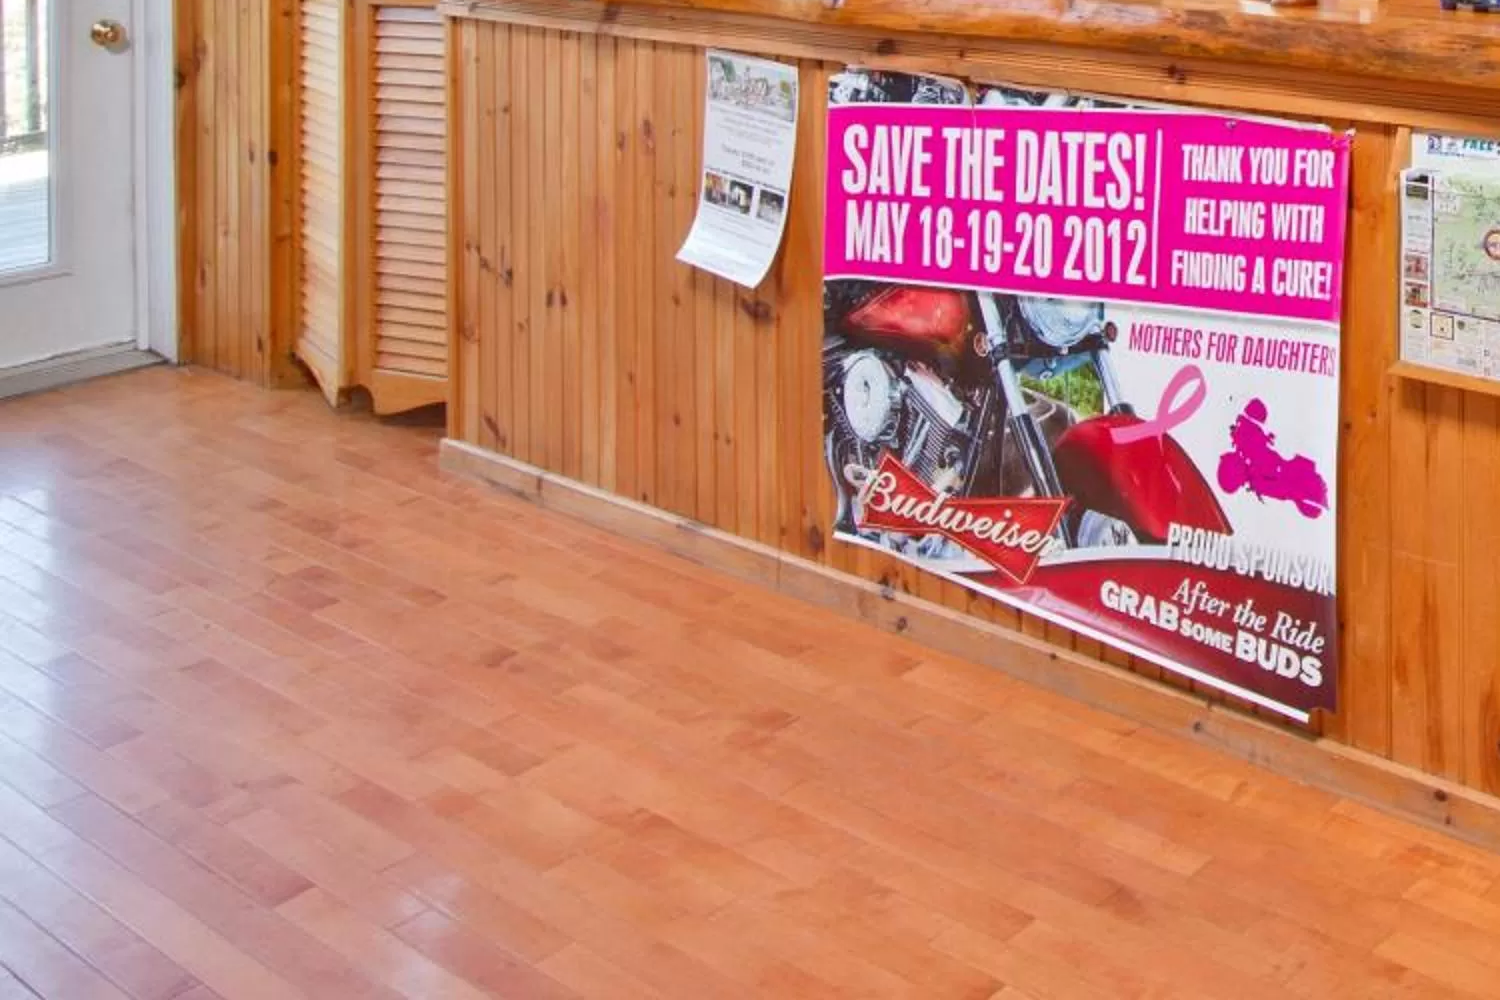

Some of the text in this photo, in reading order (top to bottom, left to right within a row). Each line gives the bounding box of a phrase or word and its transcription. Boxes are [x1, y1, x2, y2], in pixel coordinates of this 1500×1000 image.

[841, 123, 932, 198] SAVE
[943, 126, 1005, 204] THE
[1015, 129, 1147, 213] DATES!
[1181, 144, 1335, 190] THANK YOU FOR
[844, 200, 1148, 286] MAY 18-19-20 2012
[1184, 197, 1325, 244] HELPING WITH
[1170, 249, 1333, 302] FINDING A CURE!
[1128, 322, 1336, 377] MOTHERS FOR DAUGHTERS
[843, 463, 1065, 559] Budweiser
[1168, 521, 1234, 570] PROUD
[1100, 579, 1324, 688] GRAB SOME BUDS
[1172, 578, 1326, 655] After the Ride
